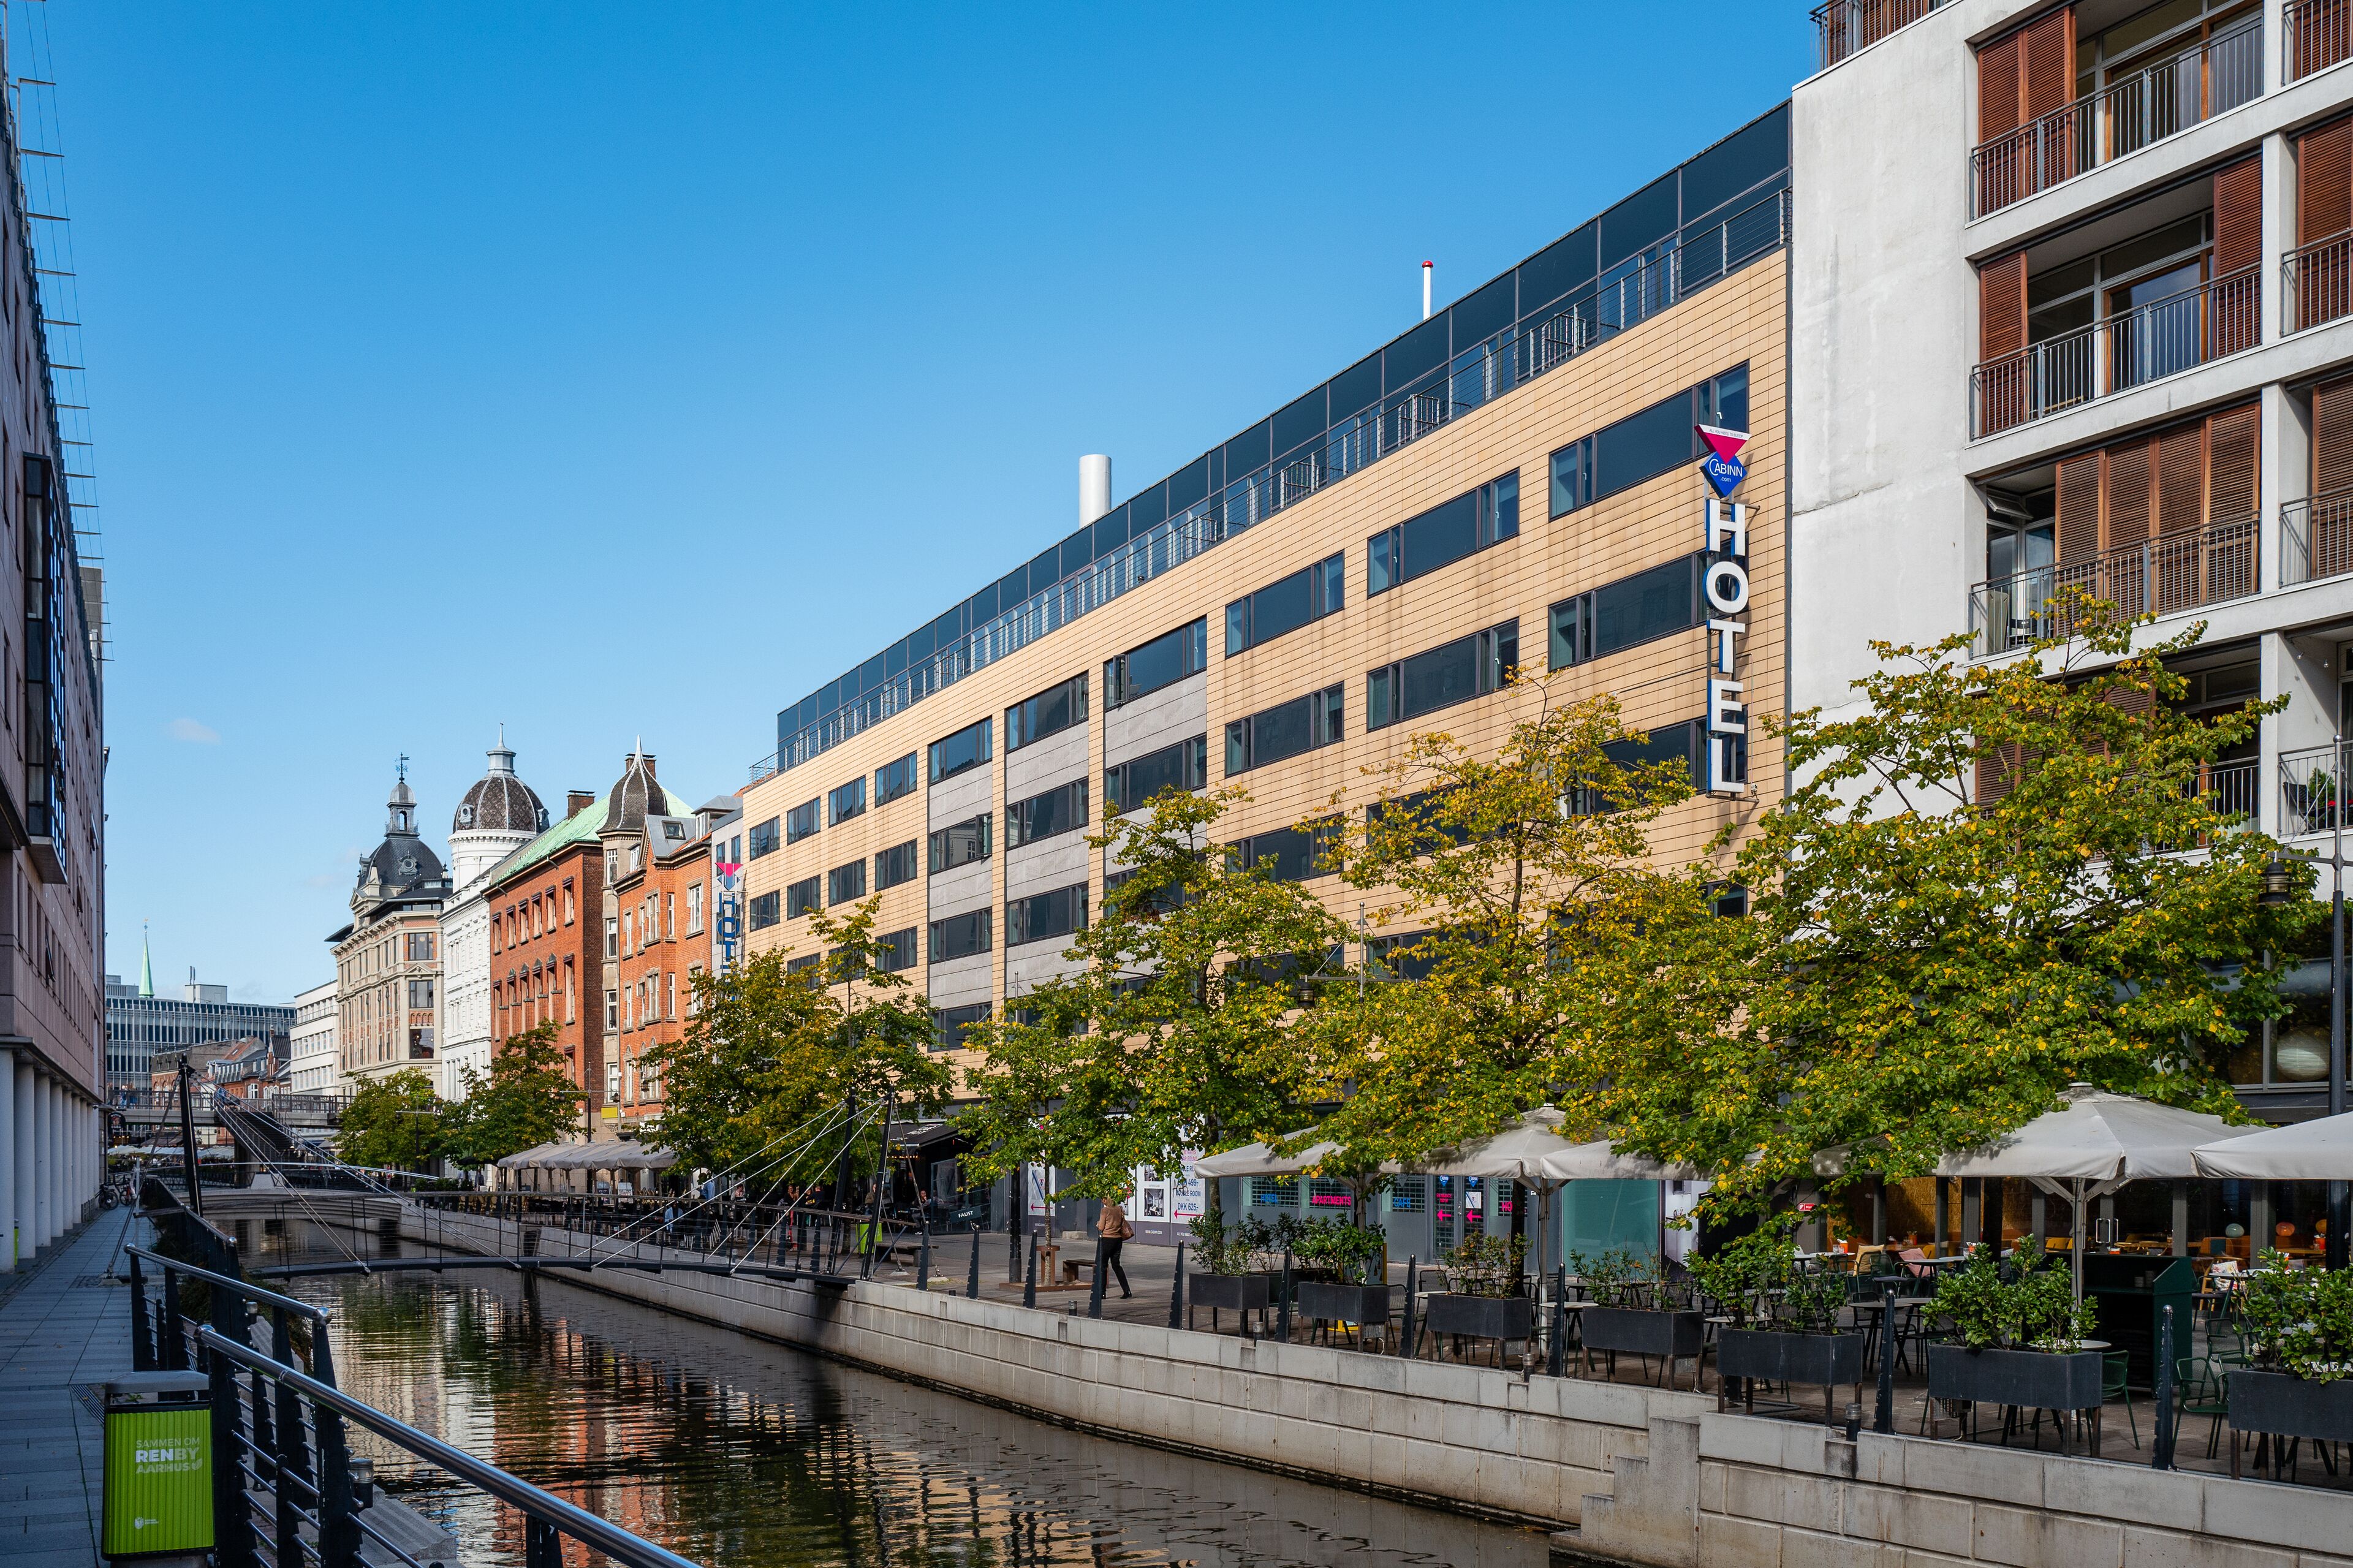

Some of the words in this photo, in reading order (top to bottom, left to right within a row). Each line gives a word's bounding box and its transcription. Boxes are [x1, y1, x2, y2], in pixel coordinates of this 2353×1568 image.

[1709, 458, 1743, 477] CABINN
[1703, 498, 1749, 793] HOTEL
[1260, 1194, 1278, 1203] HOTEL
[1312, 1195, 1351, 1205] APARTMENTS
[1178, 1202, 1187, 1211] DKK
[136, 1438, 181, 1448] SAMMEN
[135, 1447, 200, 1463] RENBY
[135, 1463, 191, 1474] AARHUS
